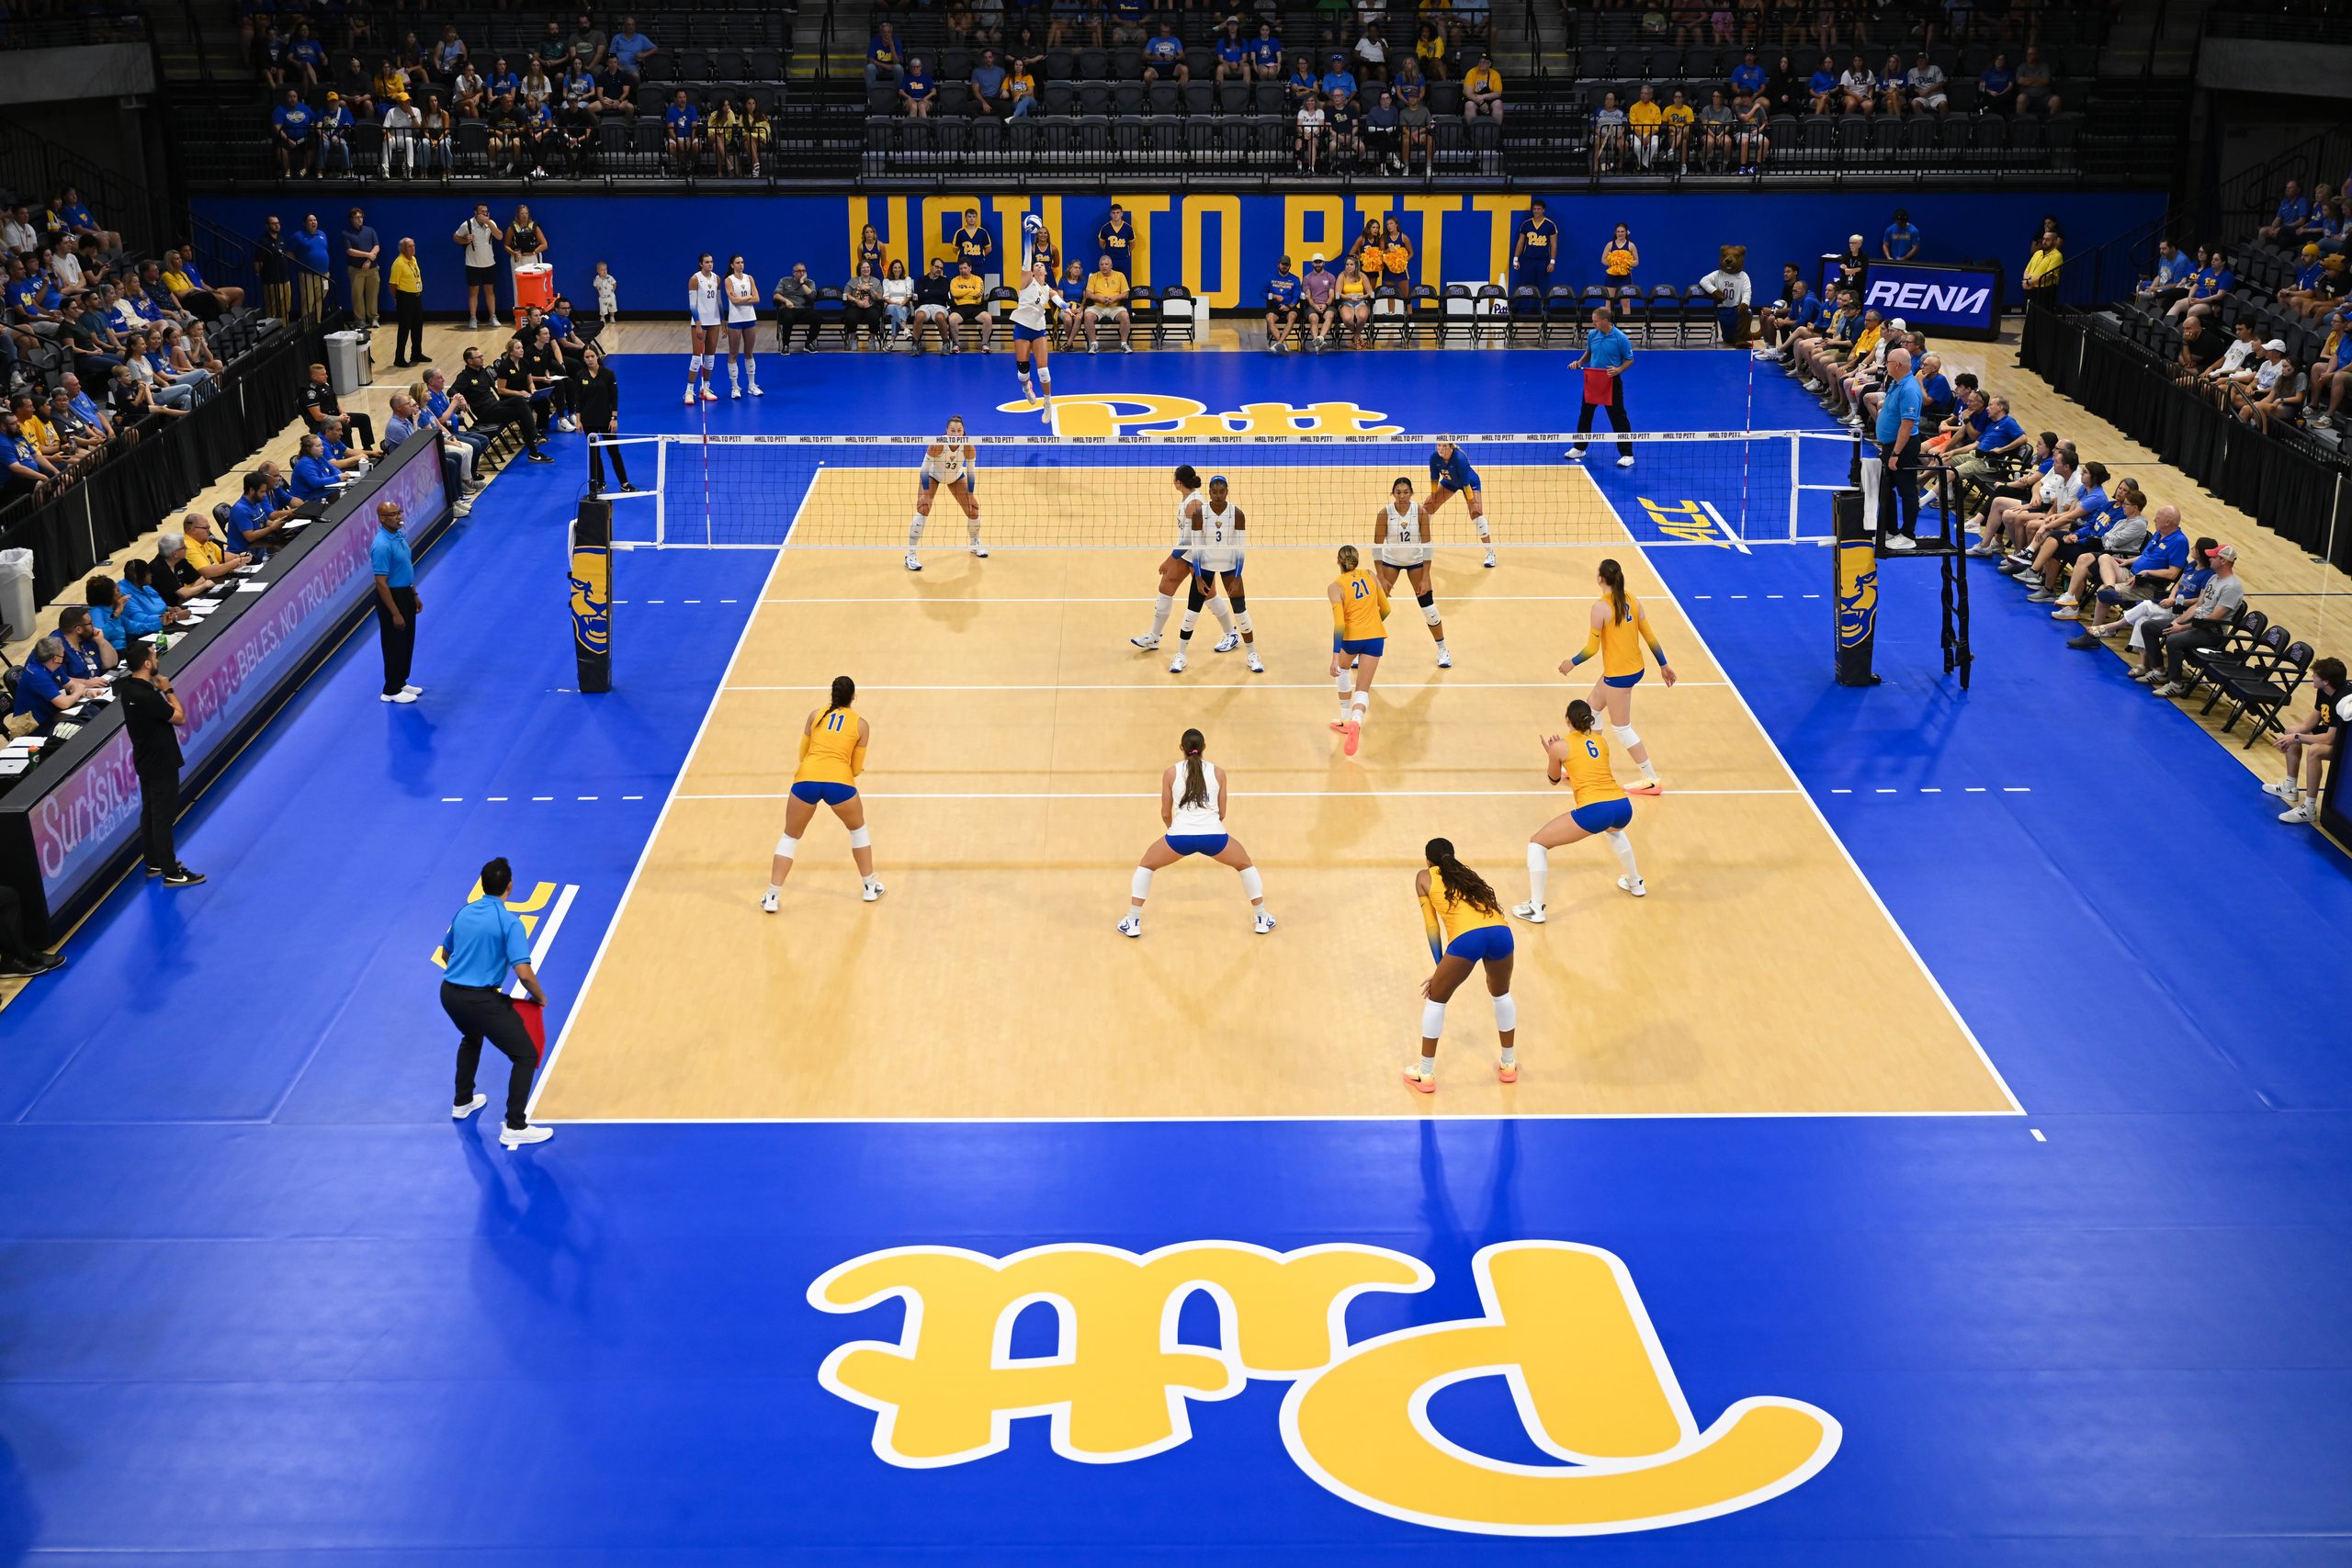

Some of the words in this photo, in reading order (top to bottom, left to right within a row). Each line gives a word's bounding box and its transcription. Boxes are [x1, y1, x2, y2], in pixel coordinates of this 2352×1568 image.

[1108, 235, 1125, 247] Pitt
[1527, 231, 1547, 246] Pitt
[962, 242, 980, 256] Pitt
[1111, 195, 1240, 310] TO
[707, 290, 715, 299] 20
[1494, 304, 1509, 314] Pitt
[945, 462, 957, 470] 33
[1216, 530, 1222, 542] 3
[1399, 531, 1410, 543] 12
[1351, 578, 1370, 600] 21
[278, 601, 298, 638] NO
[828, 712, 844, 731] 11
[1586, 739, 1599, 759] 6
[807, 1239, 1843, 1537] Pitt
